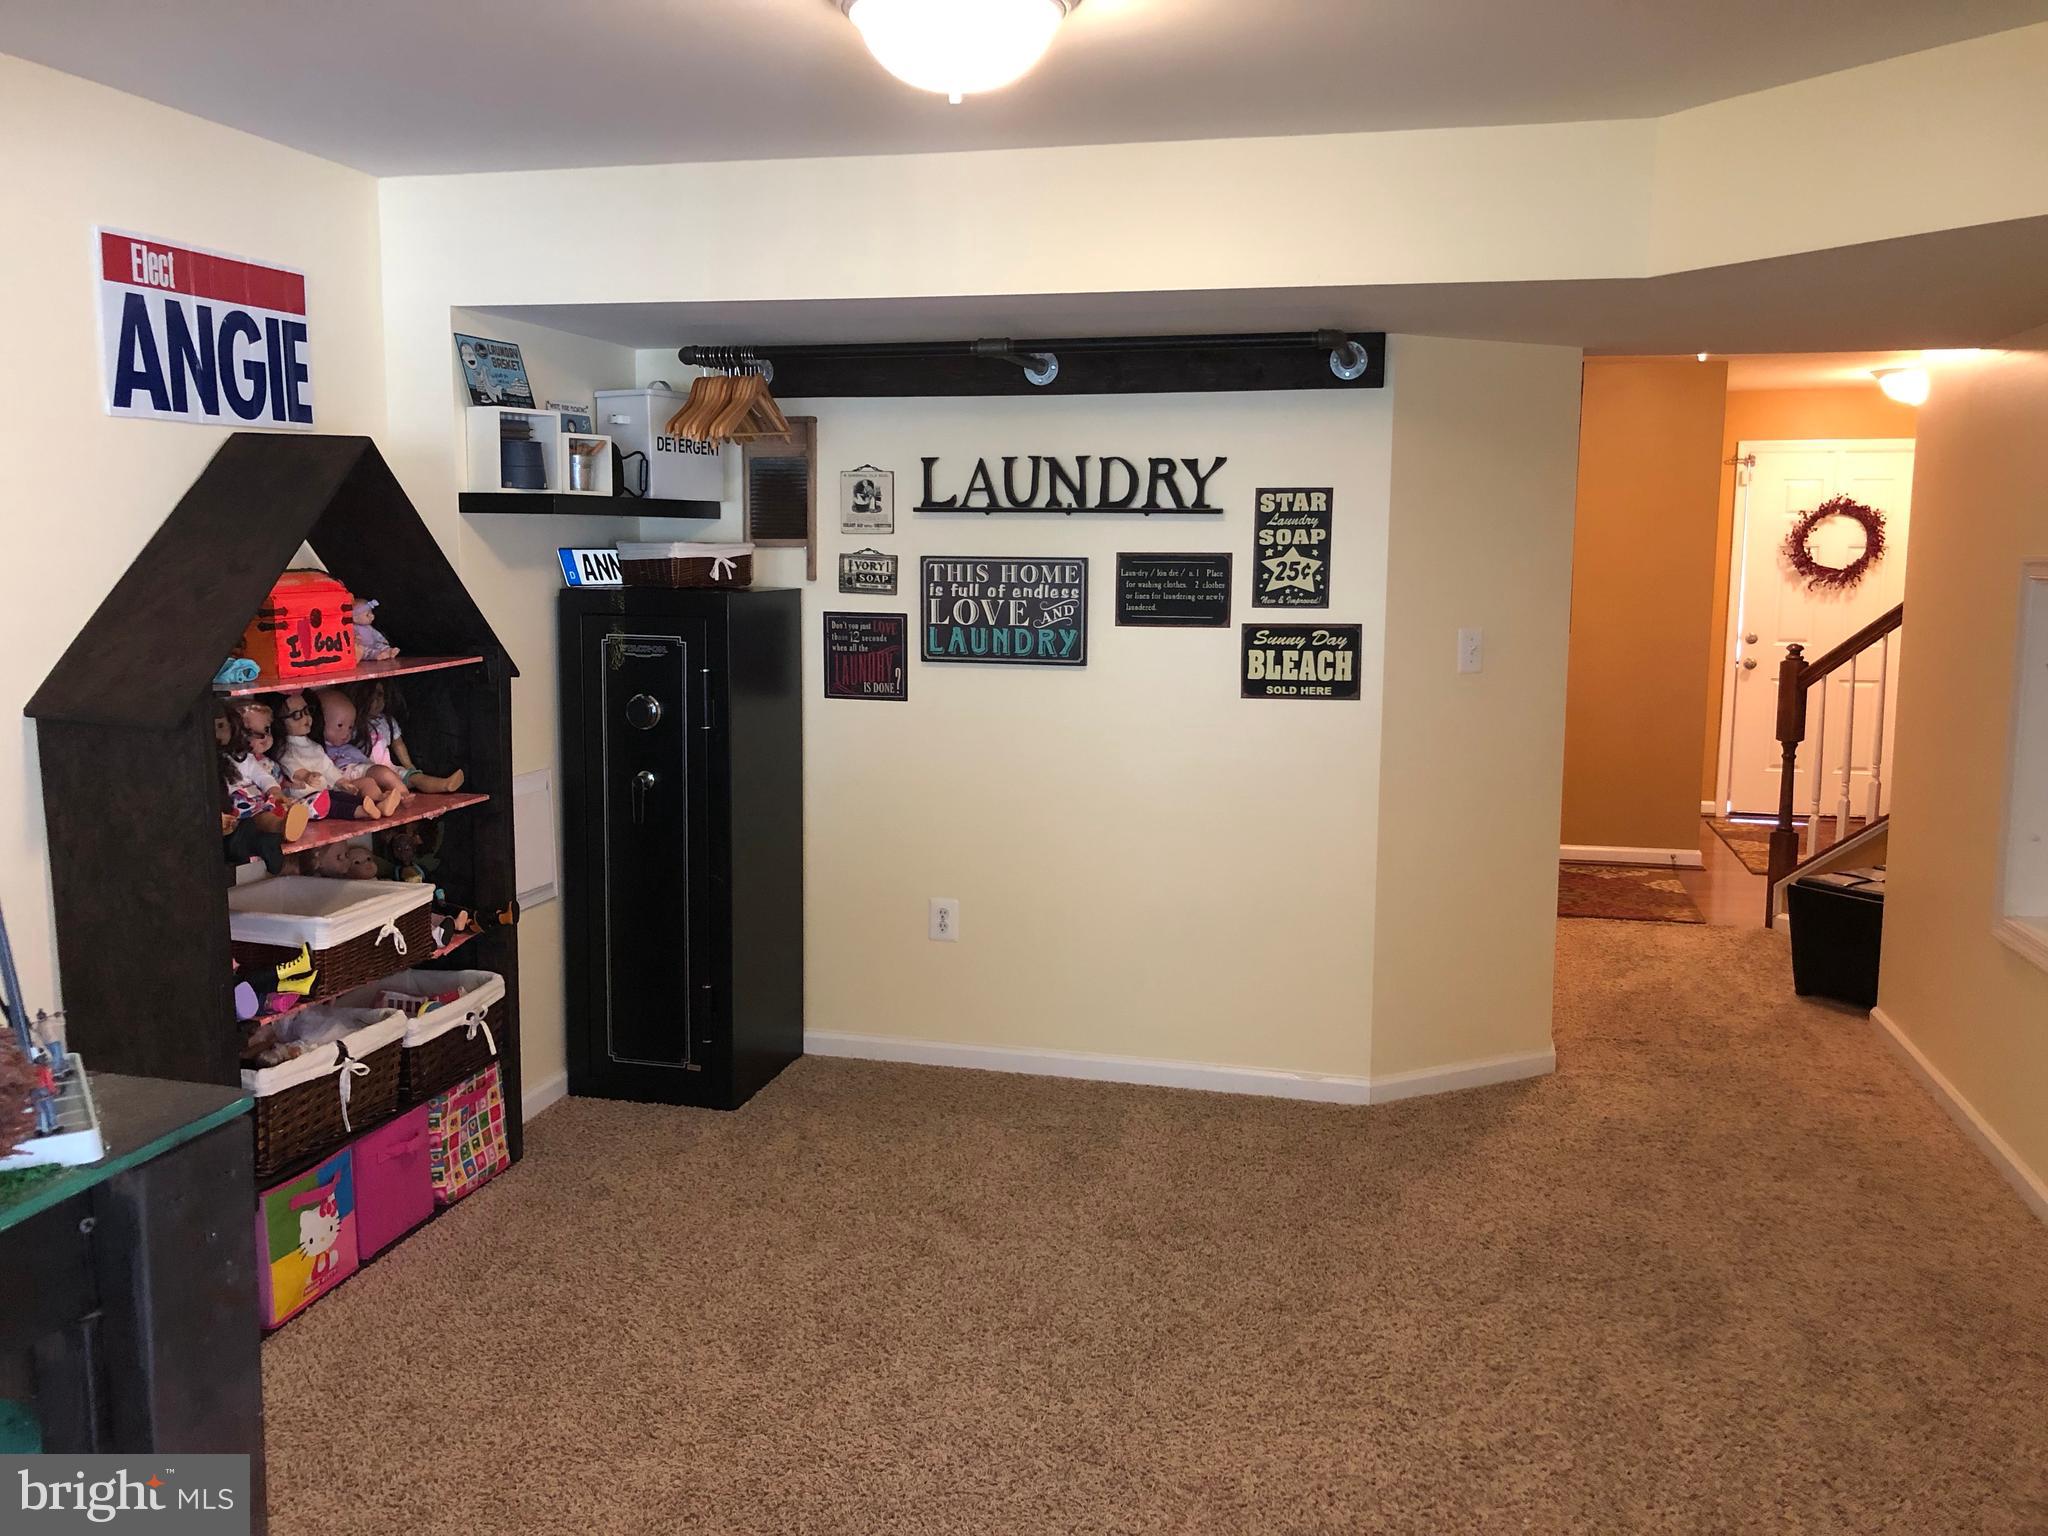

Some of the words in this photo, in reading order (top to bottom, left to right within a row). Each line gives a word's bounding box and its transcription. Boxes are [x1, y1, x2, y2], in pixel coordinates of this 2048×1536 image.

[130, 242, 176, 289] Elect
[113, 291, 314, 424] ANGIE
[487, 343, 520, 360] LAUNDRY
[491, 356, 521, 371] BASKET
[656, 435, 721, 457] DETERGENT
[920, 455, 1228, 508] LAUNDRY
[1259, 492, 1327, 513] STAR
[1266, 512, 1320, 528] Laundry
[1258, 528, 1327, 546] SOAP
[569, 570, 577, 580] D
[859, 573, 890, 583] SOAP
[929, 563, 990, 583] THIS
[1001, 564, 1080, 584] HOME
[1206, 568, 1224, 577] Place
[1274, 560, 1312, 582] 25¢
[929, 583, 944, 597] is
[951, 583, 979, 597] full
[987, 584, 1006, 598] of
[1012, 583, 1080, 599] endless
[1126, 580, 1136, 588] for
[1137, 580, 1162, 590] washing
[1202, 580, 1225, 589] clothes
[1151, 591, 1161, 600] for
[1163, 591, 1196, 602] laundering
[1205, 592, 1225, 603] newly
[929, 598, 1030, 626] LOVE
[1040, 603, 1075, 625] AND
[831, 620, 848, 630] Don't
[286, 634, 302, 658] I
[314, 631, 351, 655] God!
[850, 630, 860, 643] 12
[861, 633, 888, 642] seconds
[929, 626, 1078, 657] LAUNDRY
[1253, 629, 1306, 650] Sunny
[1311, 629, 1348, 650] Day
[831, 642, 848, 652] when
[849, 643, 858, 652] all
[858, 643, 869, 652] the
[1247, 649, 1353, 682] BLEACH
[863, 681, 872, 693] IS
[1266, 685, 1297, 695] SOLD
[1300, 686, 1333, 696] HERE
